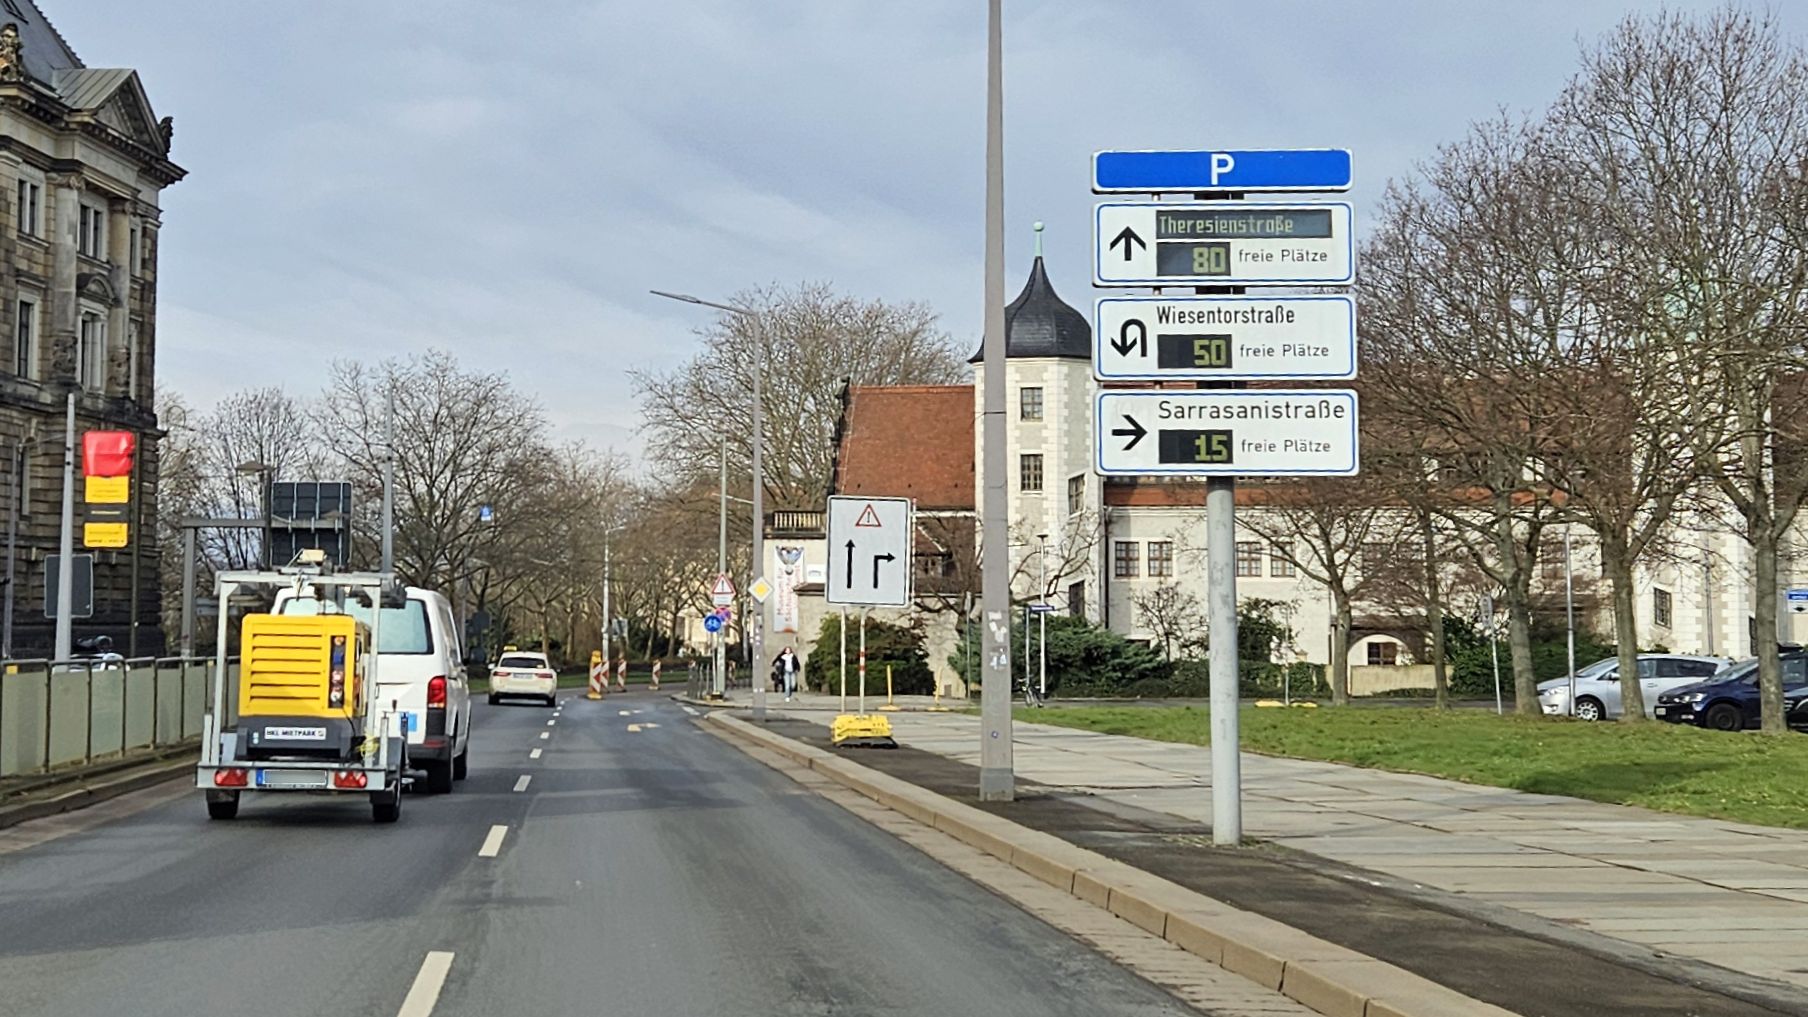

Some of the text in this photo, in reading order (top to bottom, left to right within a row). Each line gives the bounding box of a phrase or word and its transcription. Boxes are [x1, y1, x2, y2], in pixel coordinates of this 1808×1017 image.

[1210, 153, 1235, 185] P
[1159, 215, 1293, 236] Theresienstraße
[1192, 247, 1226, 274] 80
[1239, 248, 1328, 263] freie Plätze
[1157, 305, 1295, 324] Wiesentorstraße
[1194, 339, 1226, 366] 50
[1240, 344, 1329, 358] freie Plätze
[1158, 400, 1346, 420] Sarrasanistraße
[1194, 434, 1229, 462] 15
[1241, 439, 1331, 453] freie Plätze
